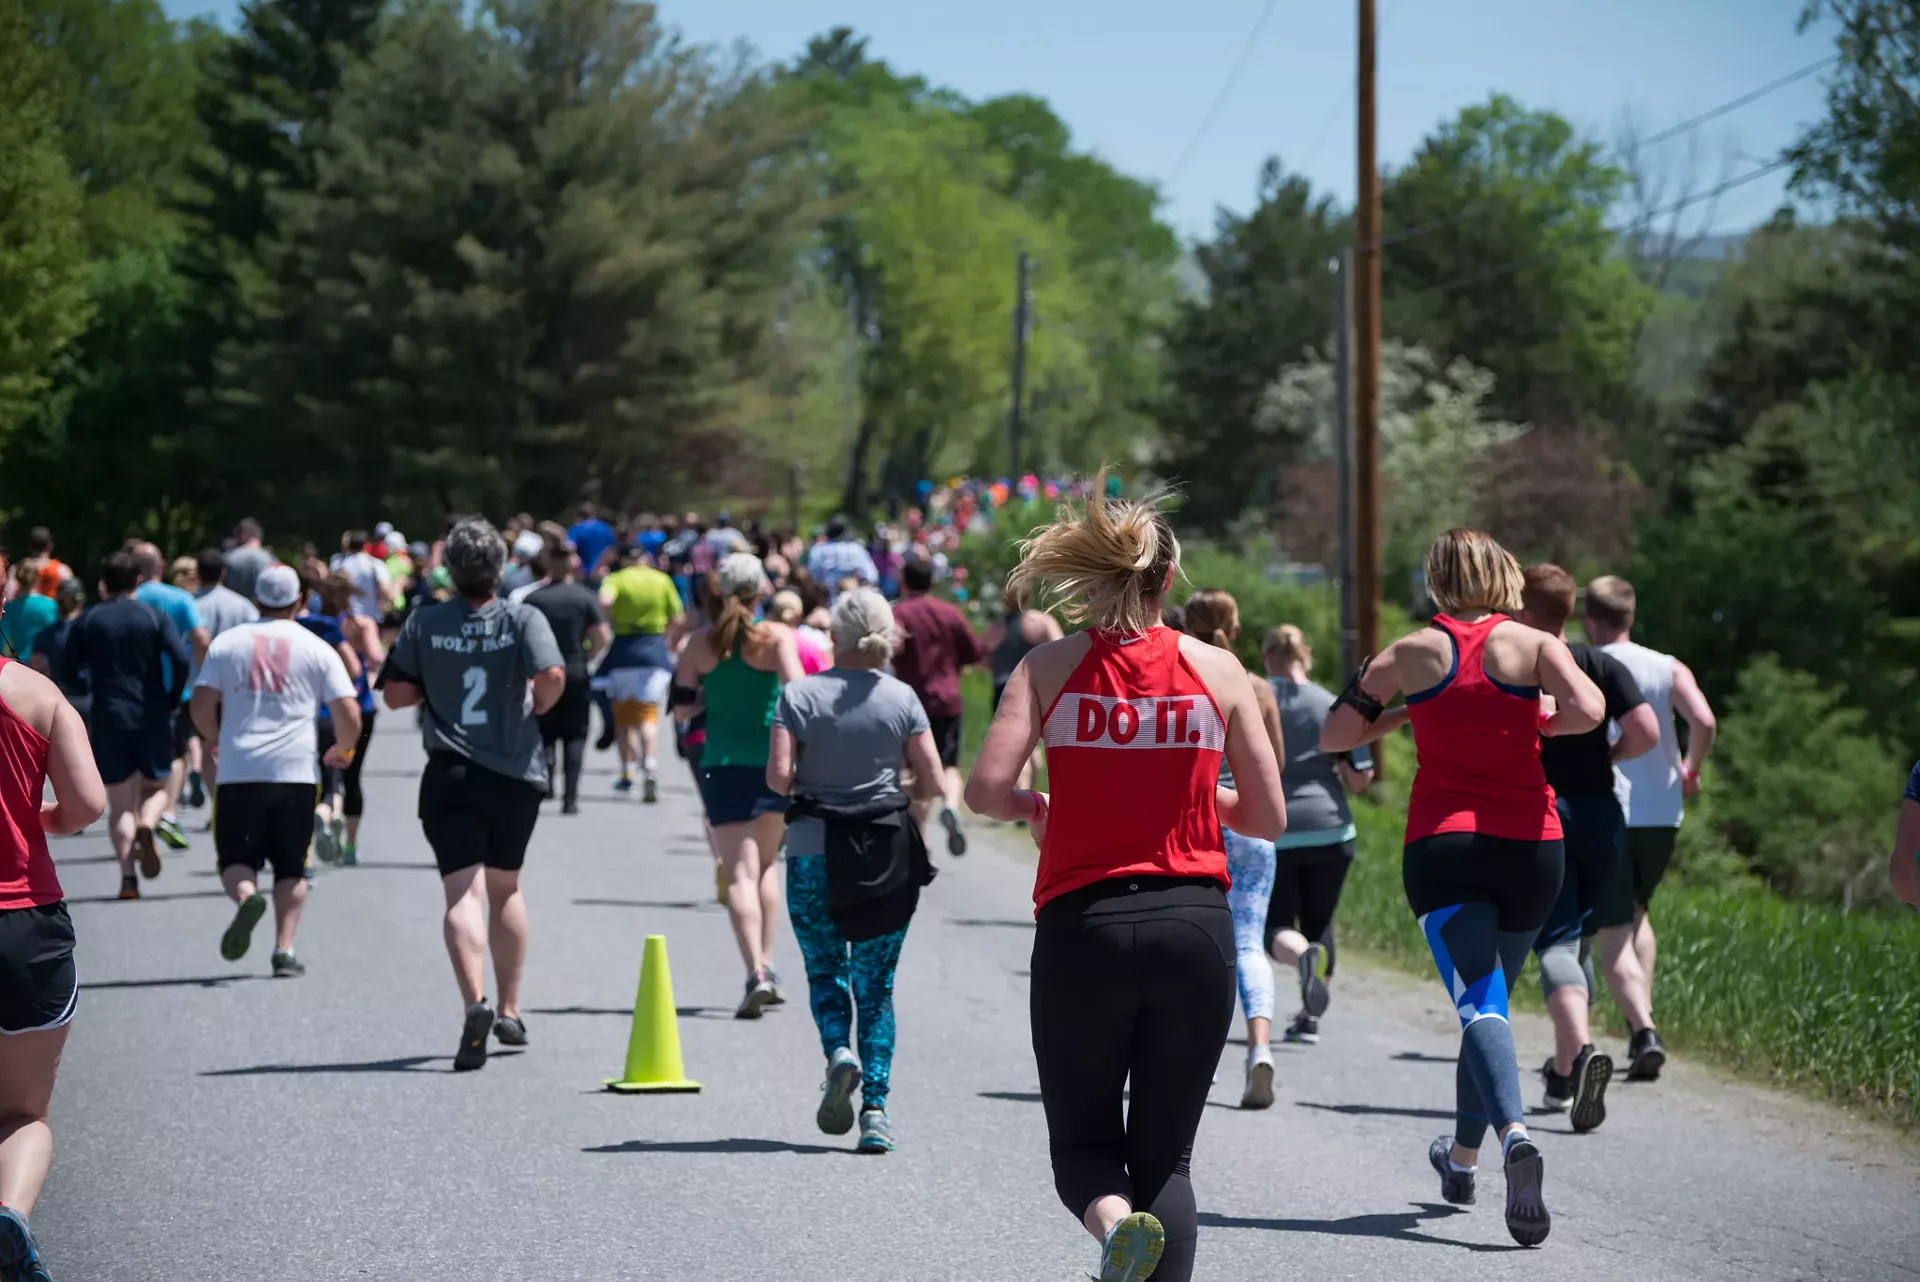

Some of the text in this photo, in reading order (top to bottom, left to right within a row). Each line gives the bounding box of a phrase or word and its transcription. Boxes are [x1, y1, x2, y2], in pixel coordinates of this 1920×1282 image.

[431, 635, 477, 653] WOLF
[461, 665, 488, 725] 2
[1076, 697, 1201, 745] DO IT.
